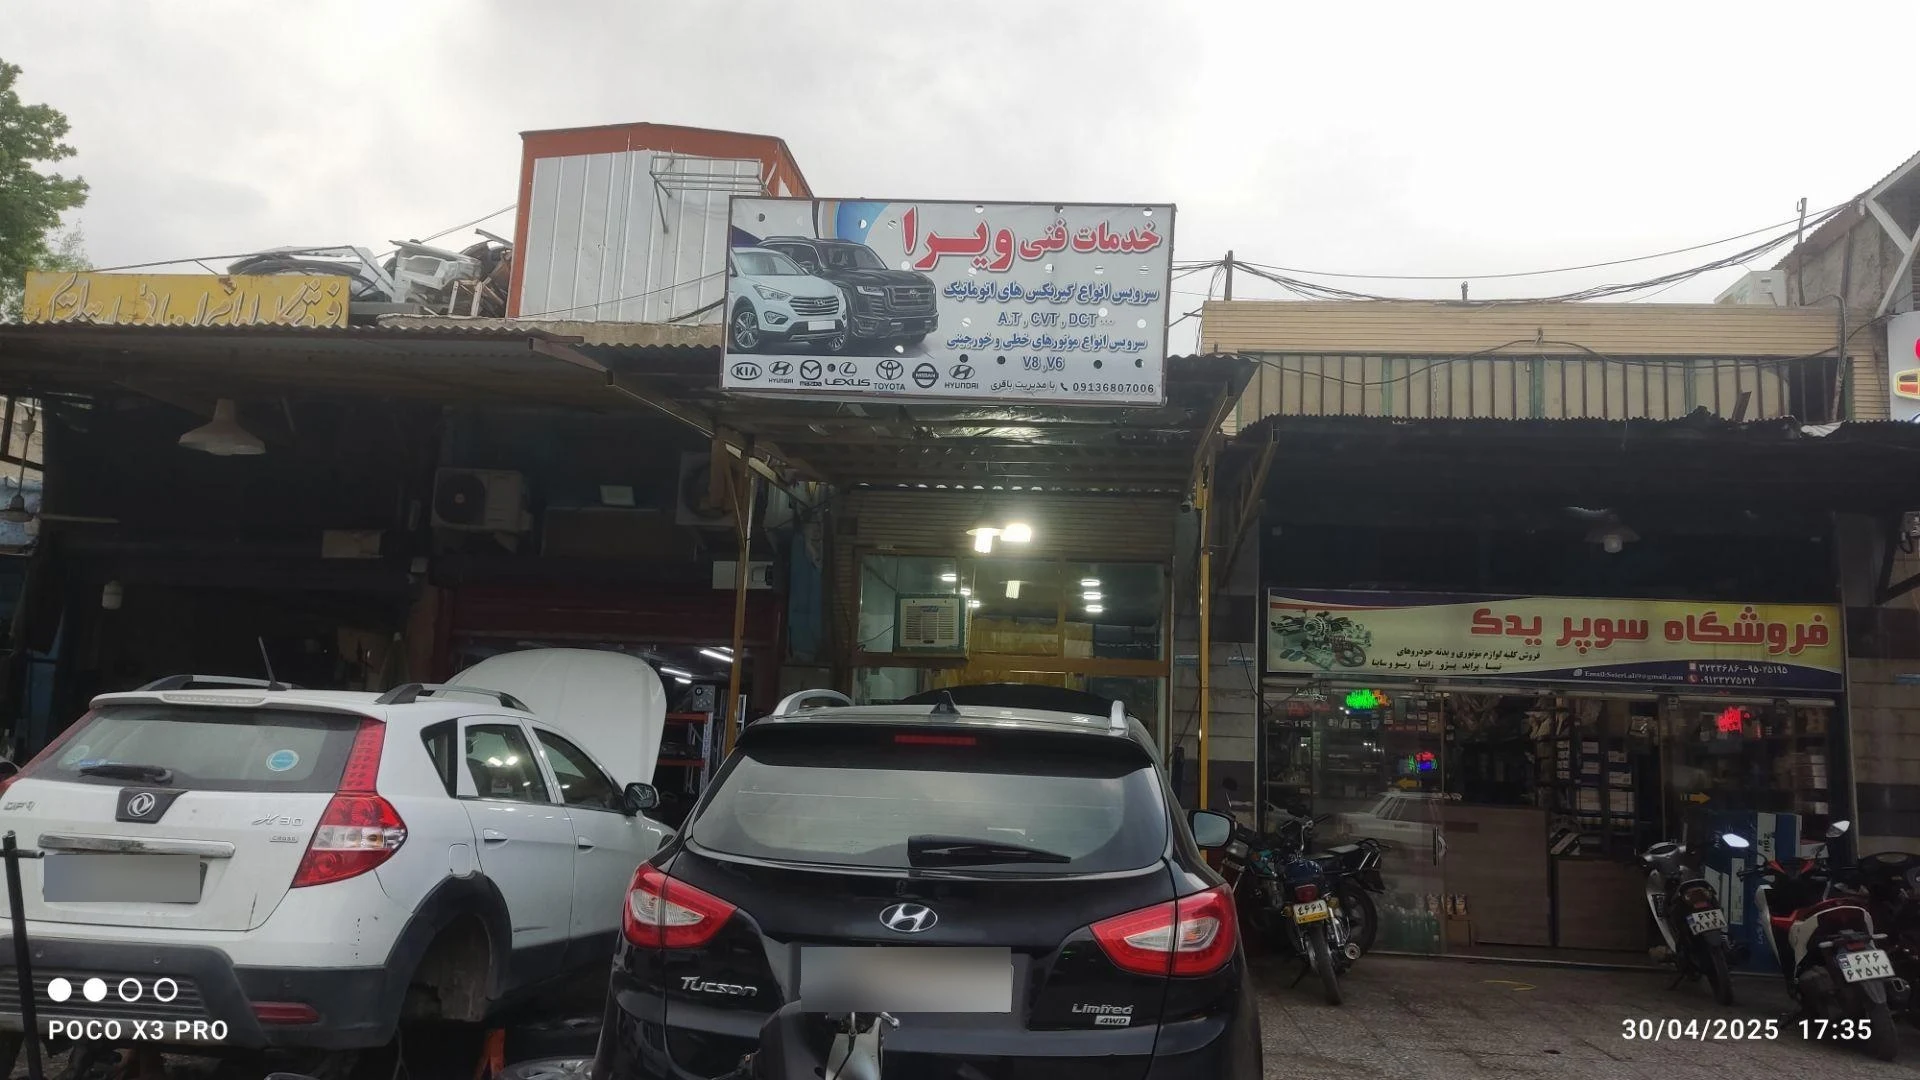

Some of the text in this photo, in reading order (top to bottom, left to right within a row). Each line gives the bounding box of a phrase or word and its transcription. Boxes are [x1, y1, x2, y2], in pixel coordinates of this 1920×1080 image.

[902, 206, 1162, 272] خدمات فنی ویرا
[943, 280, 1159, 303] سرویس انواع گیربکس های اتوماتیک
[1031, 312, 1058, 326] CVT
[1069, 313, 1097, 326] DCT
[993, 336, 1000, 349] و
[1002, 333, 1031, 350] خطی
[1030, 333, 1080, 351] موتورهای
[1081, 333, 1108, 351] انواع
[1109, 337, 1147, 352] سرویس
[735, 366, 758, 377] KIA
[825, 378, 871, 387] LEXUS
[873, 382, 906, 391] TOYOTA
[944, 382, 979, 390] HYUNDAI
[990, 379, 1013, 392] باقری
[1014, 380, 1047, 392] مدیریت
[1072, 382, 1155, 394] 09136807006
[1470, 605, 1830, 655] فروشگاه سوپر یدک
[680, 976, 758, 997] Tucson
[1072, 1003, 1134, 1015] Limited
[1100, 1016, 1127, 1025] 4WD
